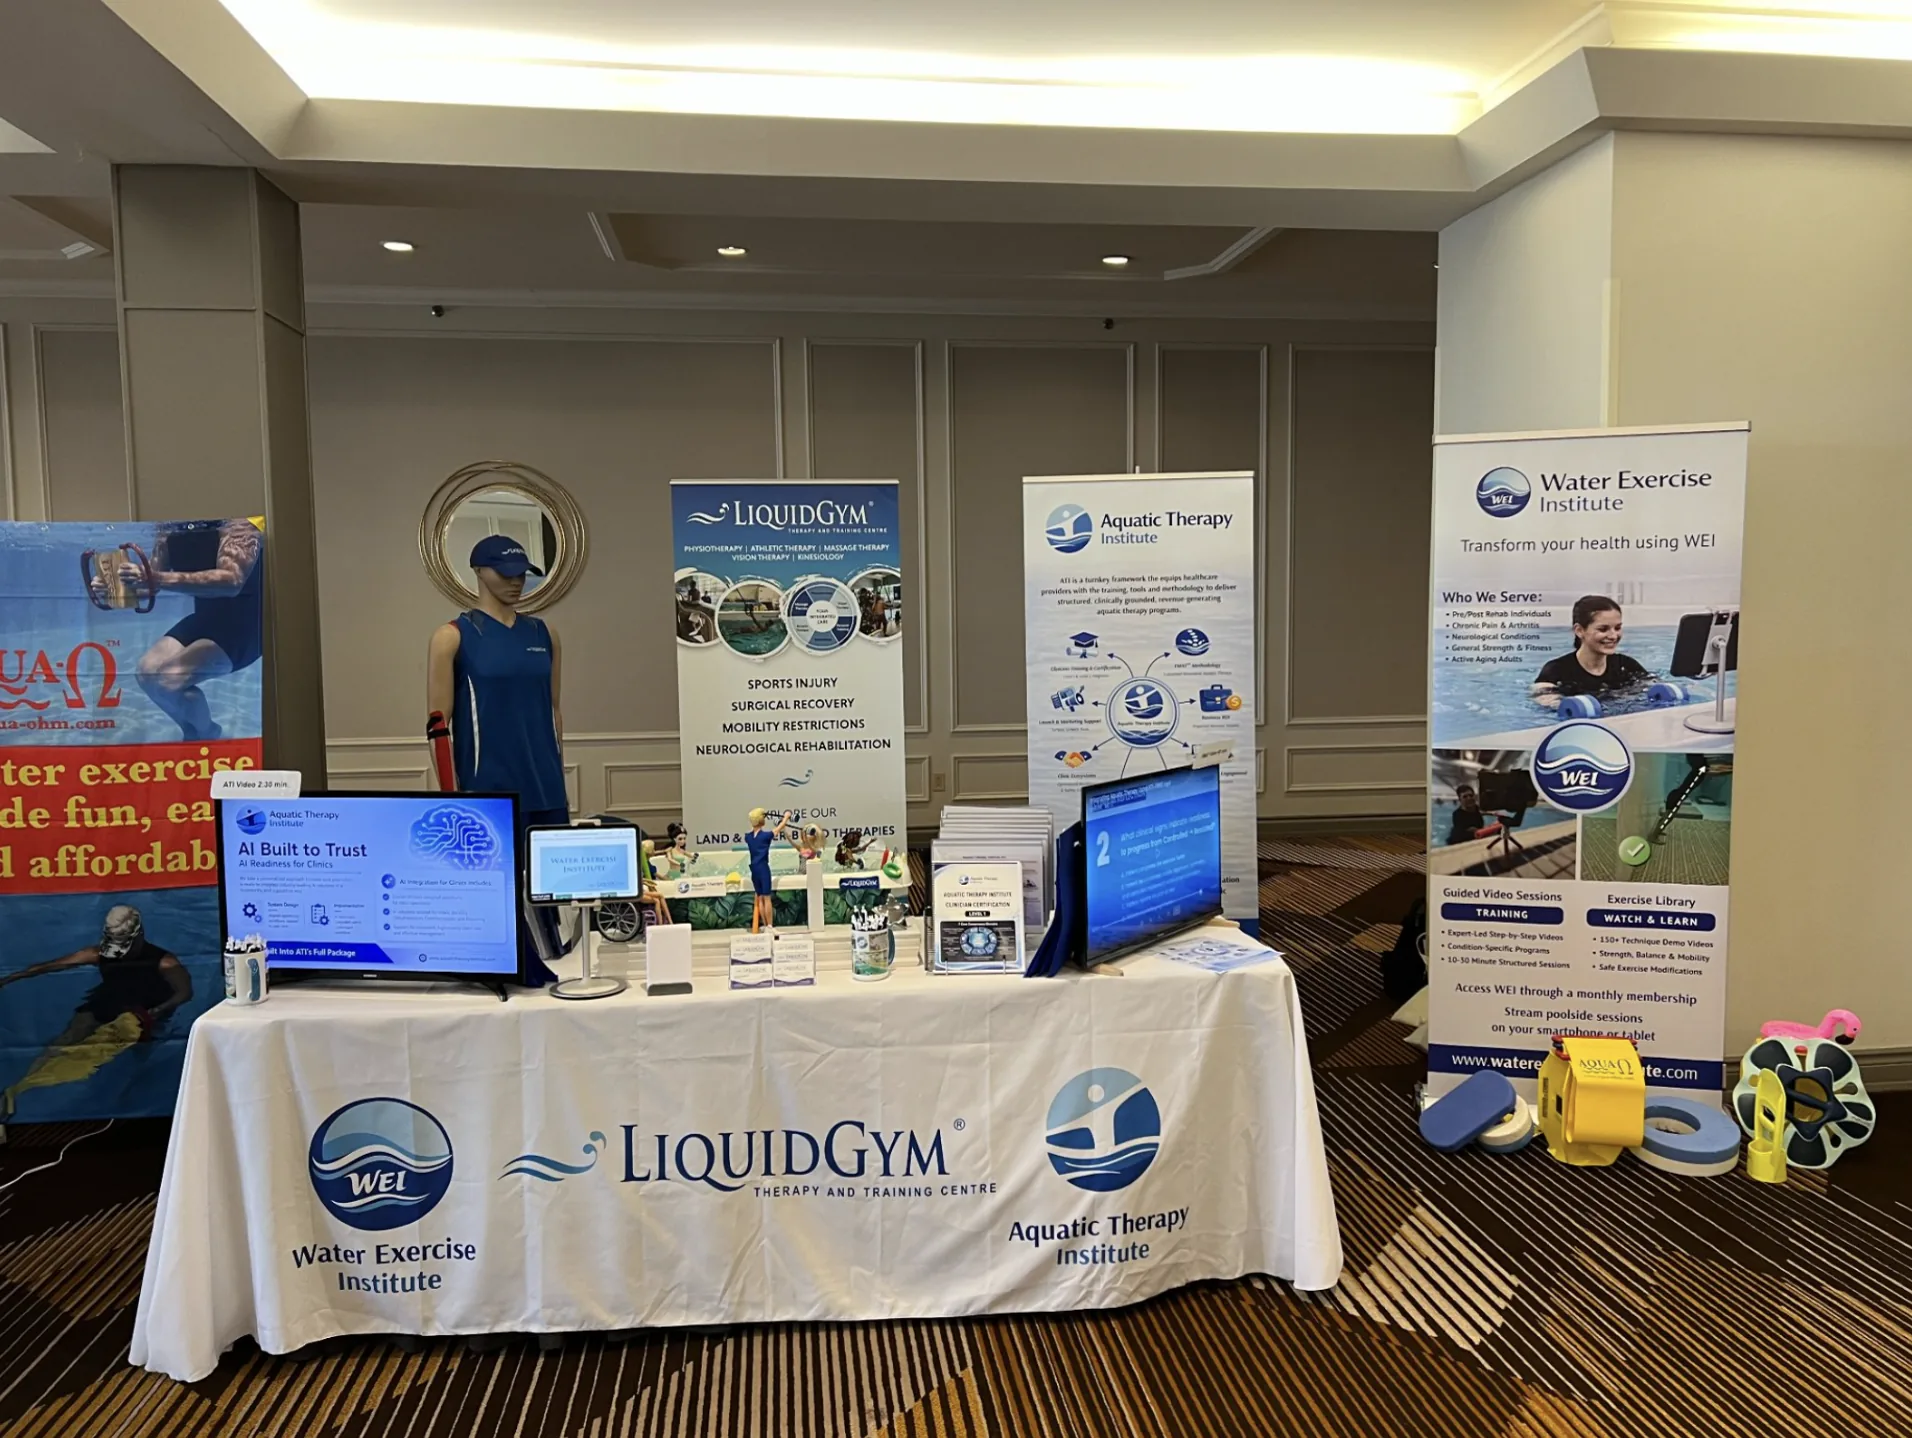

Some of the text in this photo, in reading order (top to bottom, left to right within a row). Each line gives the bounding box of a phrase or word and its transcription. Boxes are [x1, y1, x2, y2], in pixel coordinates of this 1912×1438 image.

[1541, 470, 1712, 491] Water Exercise
[1491, 494, 1513, 505] WEI
[1541, 496, 1623, 512] Institute
[1101, 512, 1233, 531] Aquatic Therapy
[1101, 532, 1158, 544] Institute
[1461, 534, 1716, 553] Transform your health using WEI
[824, 544, 857, 552] MASSAGE
[1443, 591, 1542, 602] Who We Serve:
[1097, 608, 1120, 616] aquatic
[1149, 607, 1181, 615] programs.
[1482, 644, 1514, 653] Strength
[1476, 656, 1497, 664] Aging
[748, 678, 838, 690] SPORTS INJURY
[732, 698, 855, 711] SURGICAL RECOVERY
[722, 719, 865, 733] MOBILITY RESTRICTIONS
[696, 739, 891, 756] NEUROLOGICAL REHABILITATION
[80, 746, 254, 786] exercise
[1560, 770, 1599, 787] WEI
[0, 798, 50, 829] de
[64, 796, 152, 833] fun,
[270, 810, 340, 821] Aquatic Therapy
[811, 808, 837, 819] OUR
[270, 819, 304, 828] Institute
[696, 834, 730, 845] LAND
[733, 834, 742, 843] &
[239, 842, 368, 858] AI Built to Trust
[1096, 831, 1110, 867] 2
[30, 838, 216, 878] affordab
[239, 859, 334, 869] AI Readiness for Clinics
[1443, 888, 1563, 902] Guided Video Sessions
[1607, 894, 1696, 909] Exercise Library
[1476, 909, 1529, 919] TRAINING
[1604, 914, 1698, 926] WATCH & LEARN
[1447, 929, 1564, 942] Expert-Led Step-by-Step Videos
[1600, 936, 1714, 948] 150+ Technique Demo Videos
[279, 948, 356, 958] Into ATI's Full Package
[1447, 942, 1550, 956] Condition-Specific Programs
[1471, 957, 1498, 966] Minute
[1499, 959, 1538, 968] Structured
[1539, 960, 1571, 969] Sessions
[1599, 950, 1710, 964] Strength, Balance & Mobility
[1599, 964, 1703, 976] Safe Exercise Modifications
[1455, 982, 1697, 1005] Access WEI through a monthly membership
[1504, 1007, 1643, 1024] Stream poolside sessions
[1492, 1024, 1656, 1041] on your smartphone or tablet
[1452, 1055, 1544, 1070] www.watere
[345, 1170, 407, 1196] WEI
[754, 1182, 997, 1198] THERAPY AND TRAINING CENTRE
[1009, 1206, 1189, 1248] Aquatic Therapy
[292, 1237, 476, 1269] Water Exercise
[1057, 1241, 1150, 1265] Institute
[338, 1271, 442, 1294] Institute
